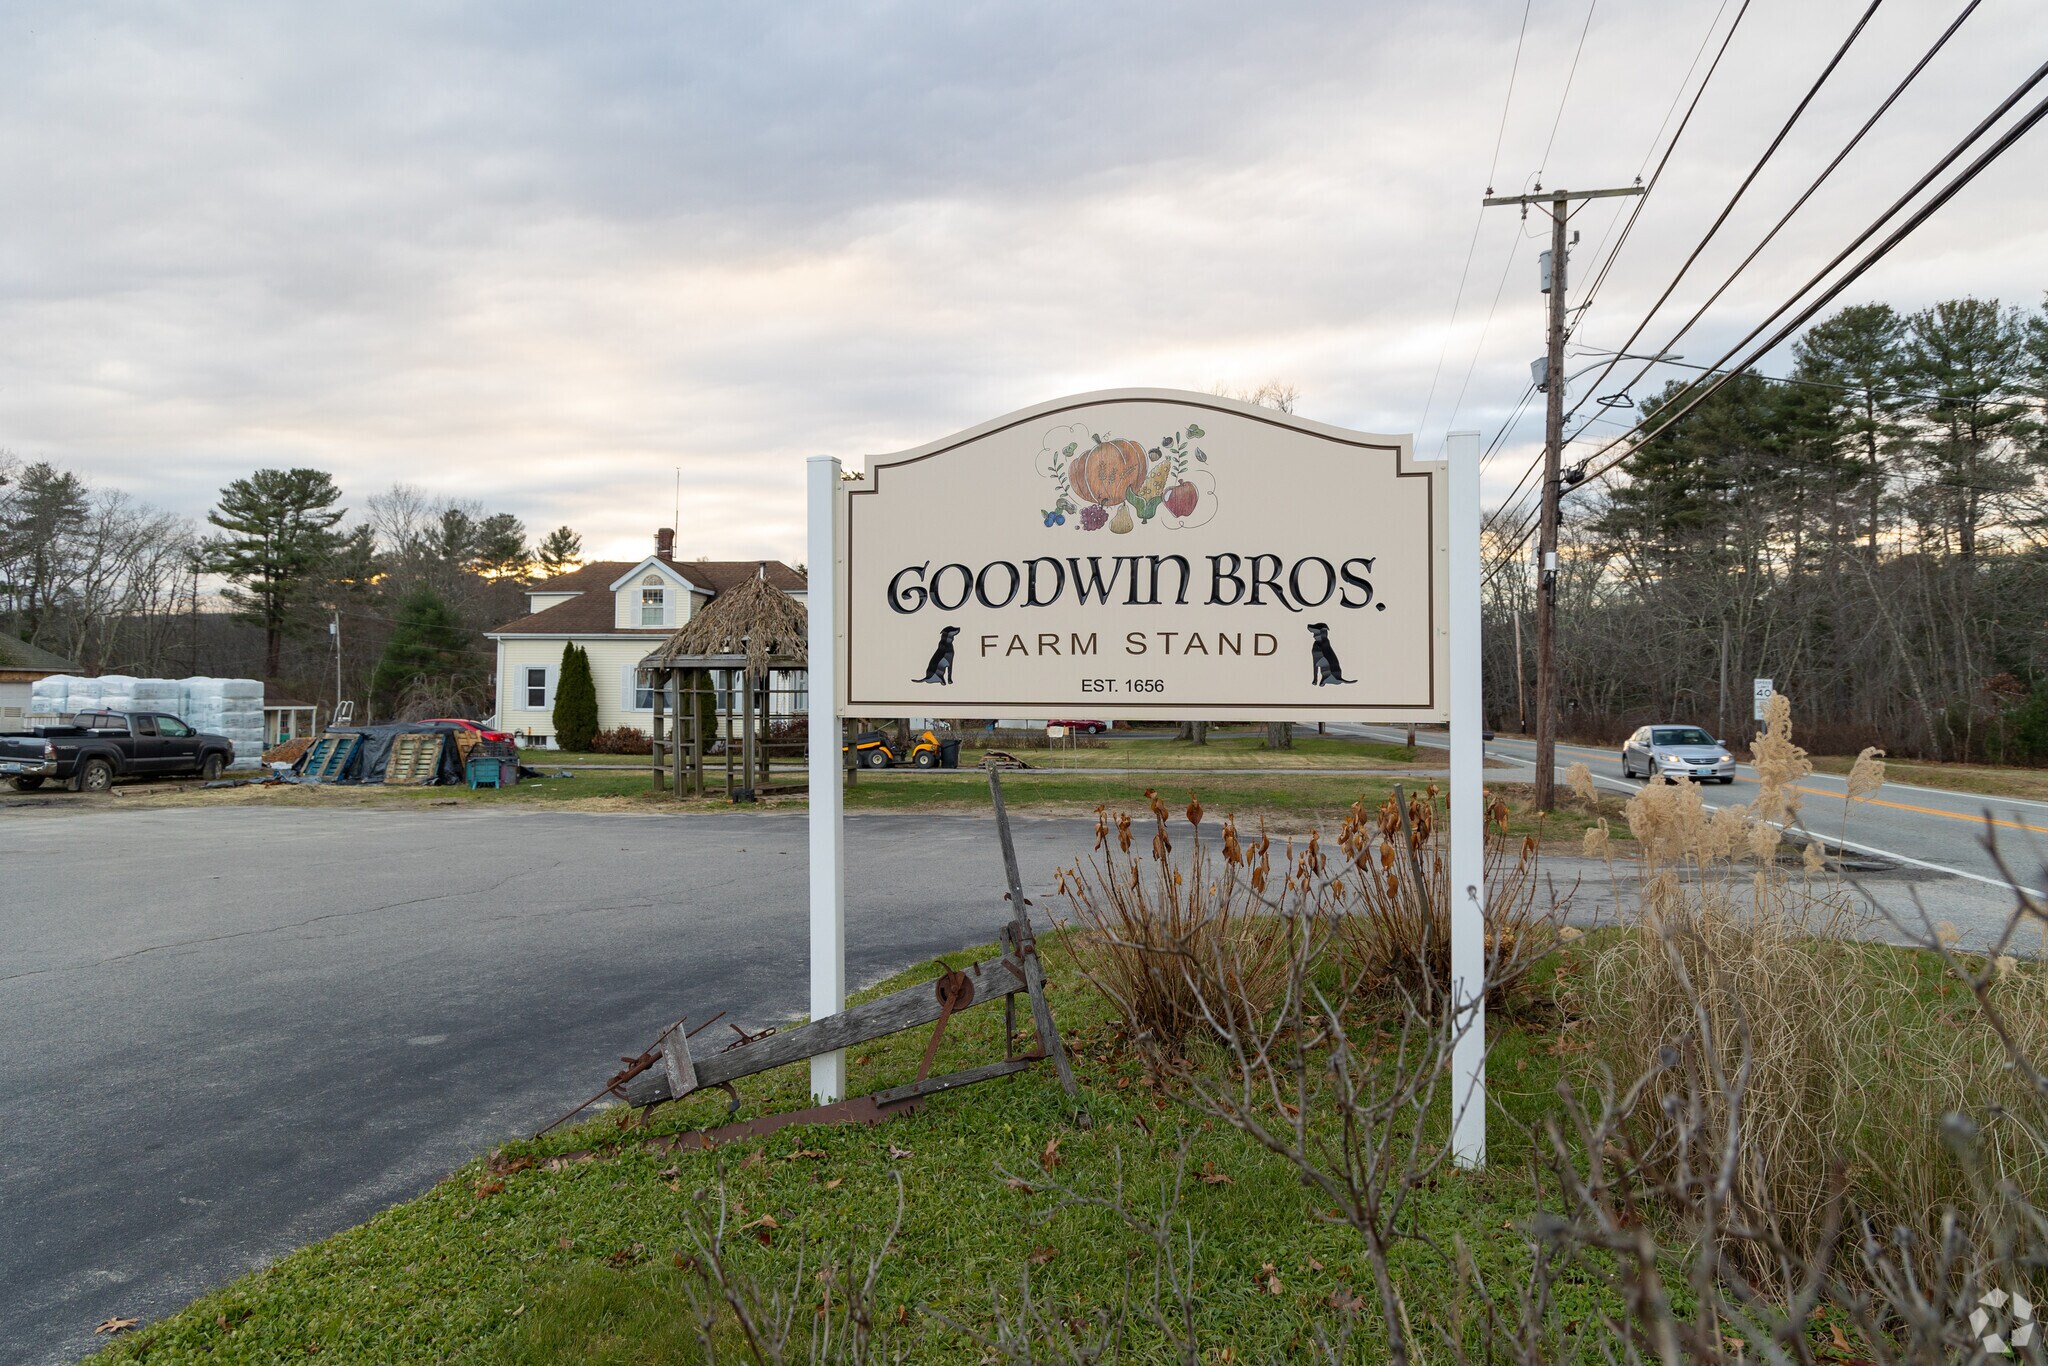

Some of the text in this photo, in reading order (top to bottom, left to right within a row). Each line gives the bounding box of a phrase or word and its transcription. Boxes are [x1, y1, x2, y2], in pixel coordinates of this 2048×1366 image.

[887, 553, 1386, 614] GOODWIN BROS.
[980, 632, 1278, 657] FARM STAND
[1081, 679, 1164, 692] EST. 1656
